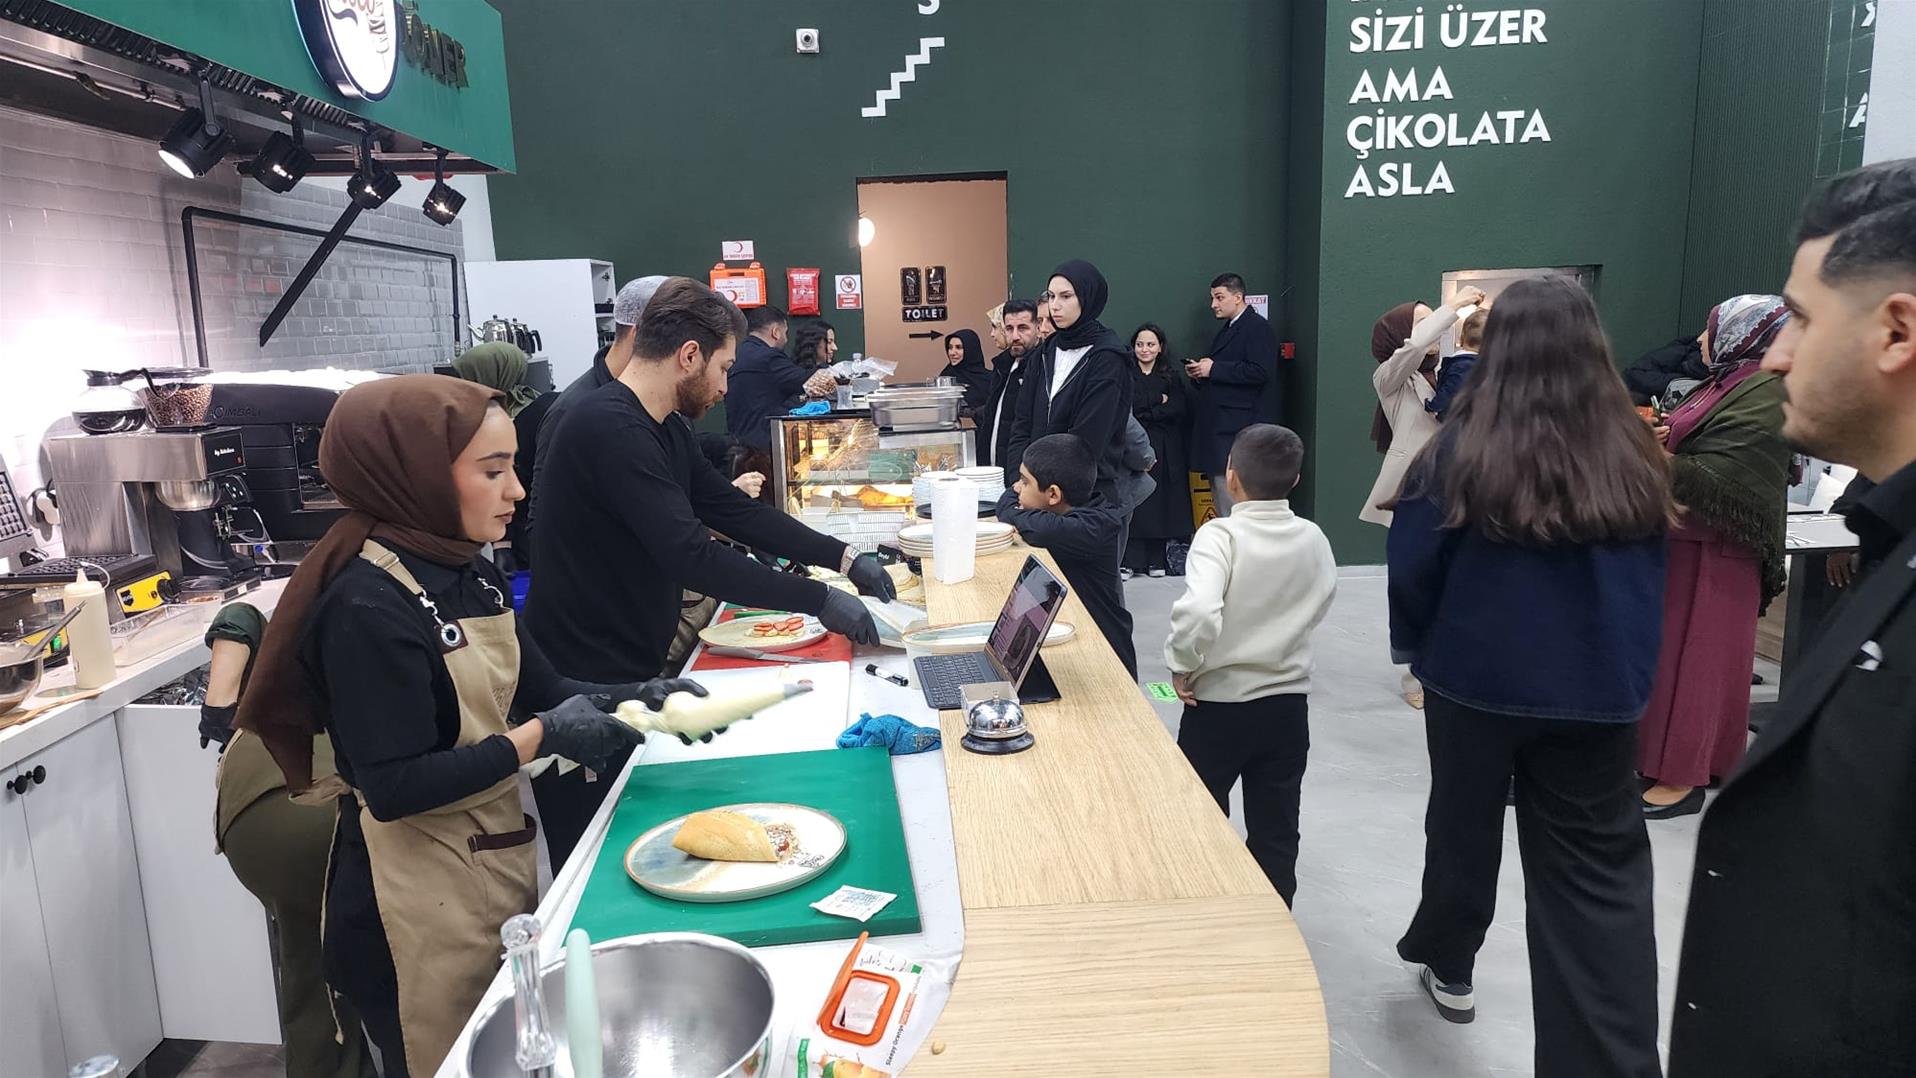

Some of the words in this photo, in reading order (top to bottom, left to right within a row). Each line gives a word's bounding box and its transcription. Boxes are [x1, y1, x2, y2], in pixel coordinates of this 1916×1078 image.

[1350, 7, 1424, 53] SİZİ
[1440, 3, 1548, 48] ÜZER
[1349, 65, 1454, 104] AMA
[1347, 108, 1552, 159] ÇİKOLATA
[1344, 160, 1455, 198] ASLA
[905, 308, 944, 319] TOILET
